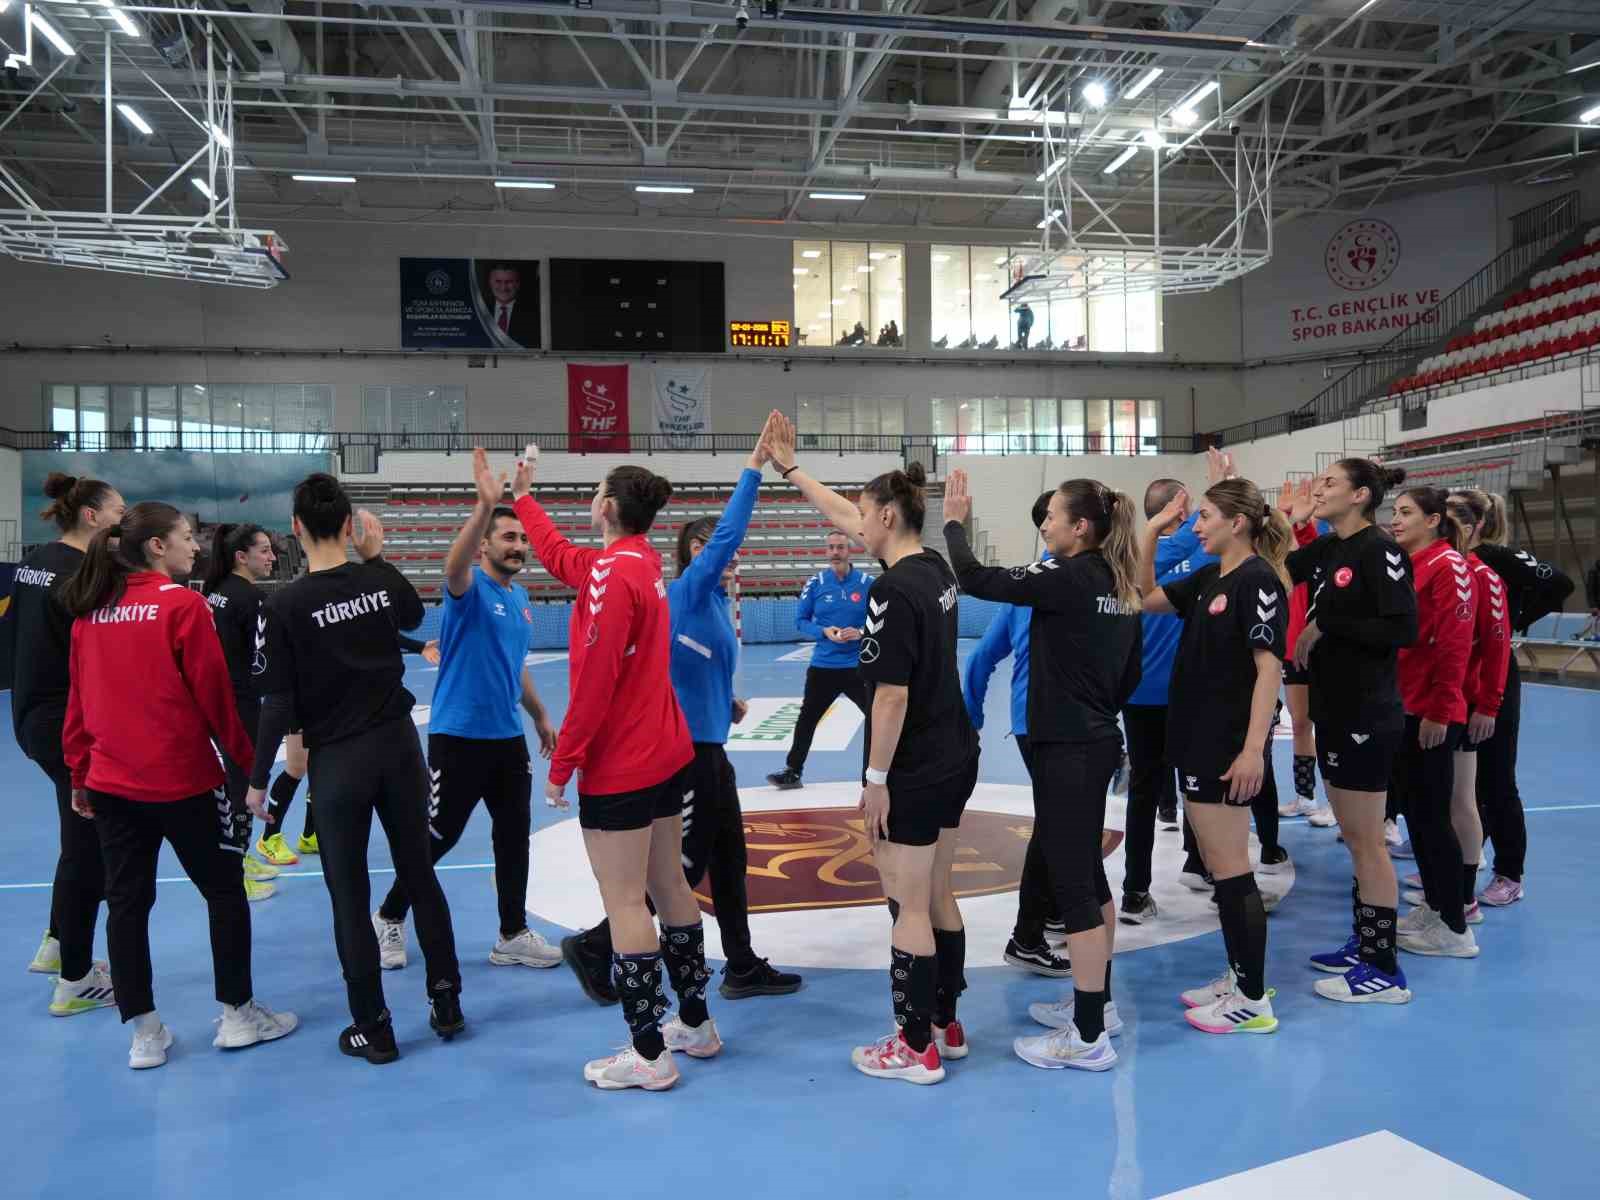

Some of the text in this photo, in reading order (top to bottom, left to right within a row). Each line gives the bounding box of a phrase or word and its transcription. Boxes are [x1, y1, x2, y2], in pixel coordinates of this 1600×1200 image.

[1291, 289, 1440, 323] T.C. GENÇLİK VE
[1292, 323, 1337, 342] SPOR
[580, 416, 617, 430] THF
[14, 565, 56, 587] TÜRKİYE
[312, 590, 390, 628] TÜRKİYE
